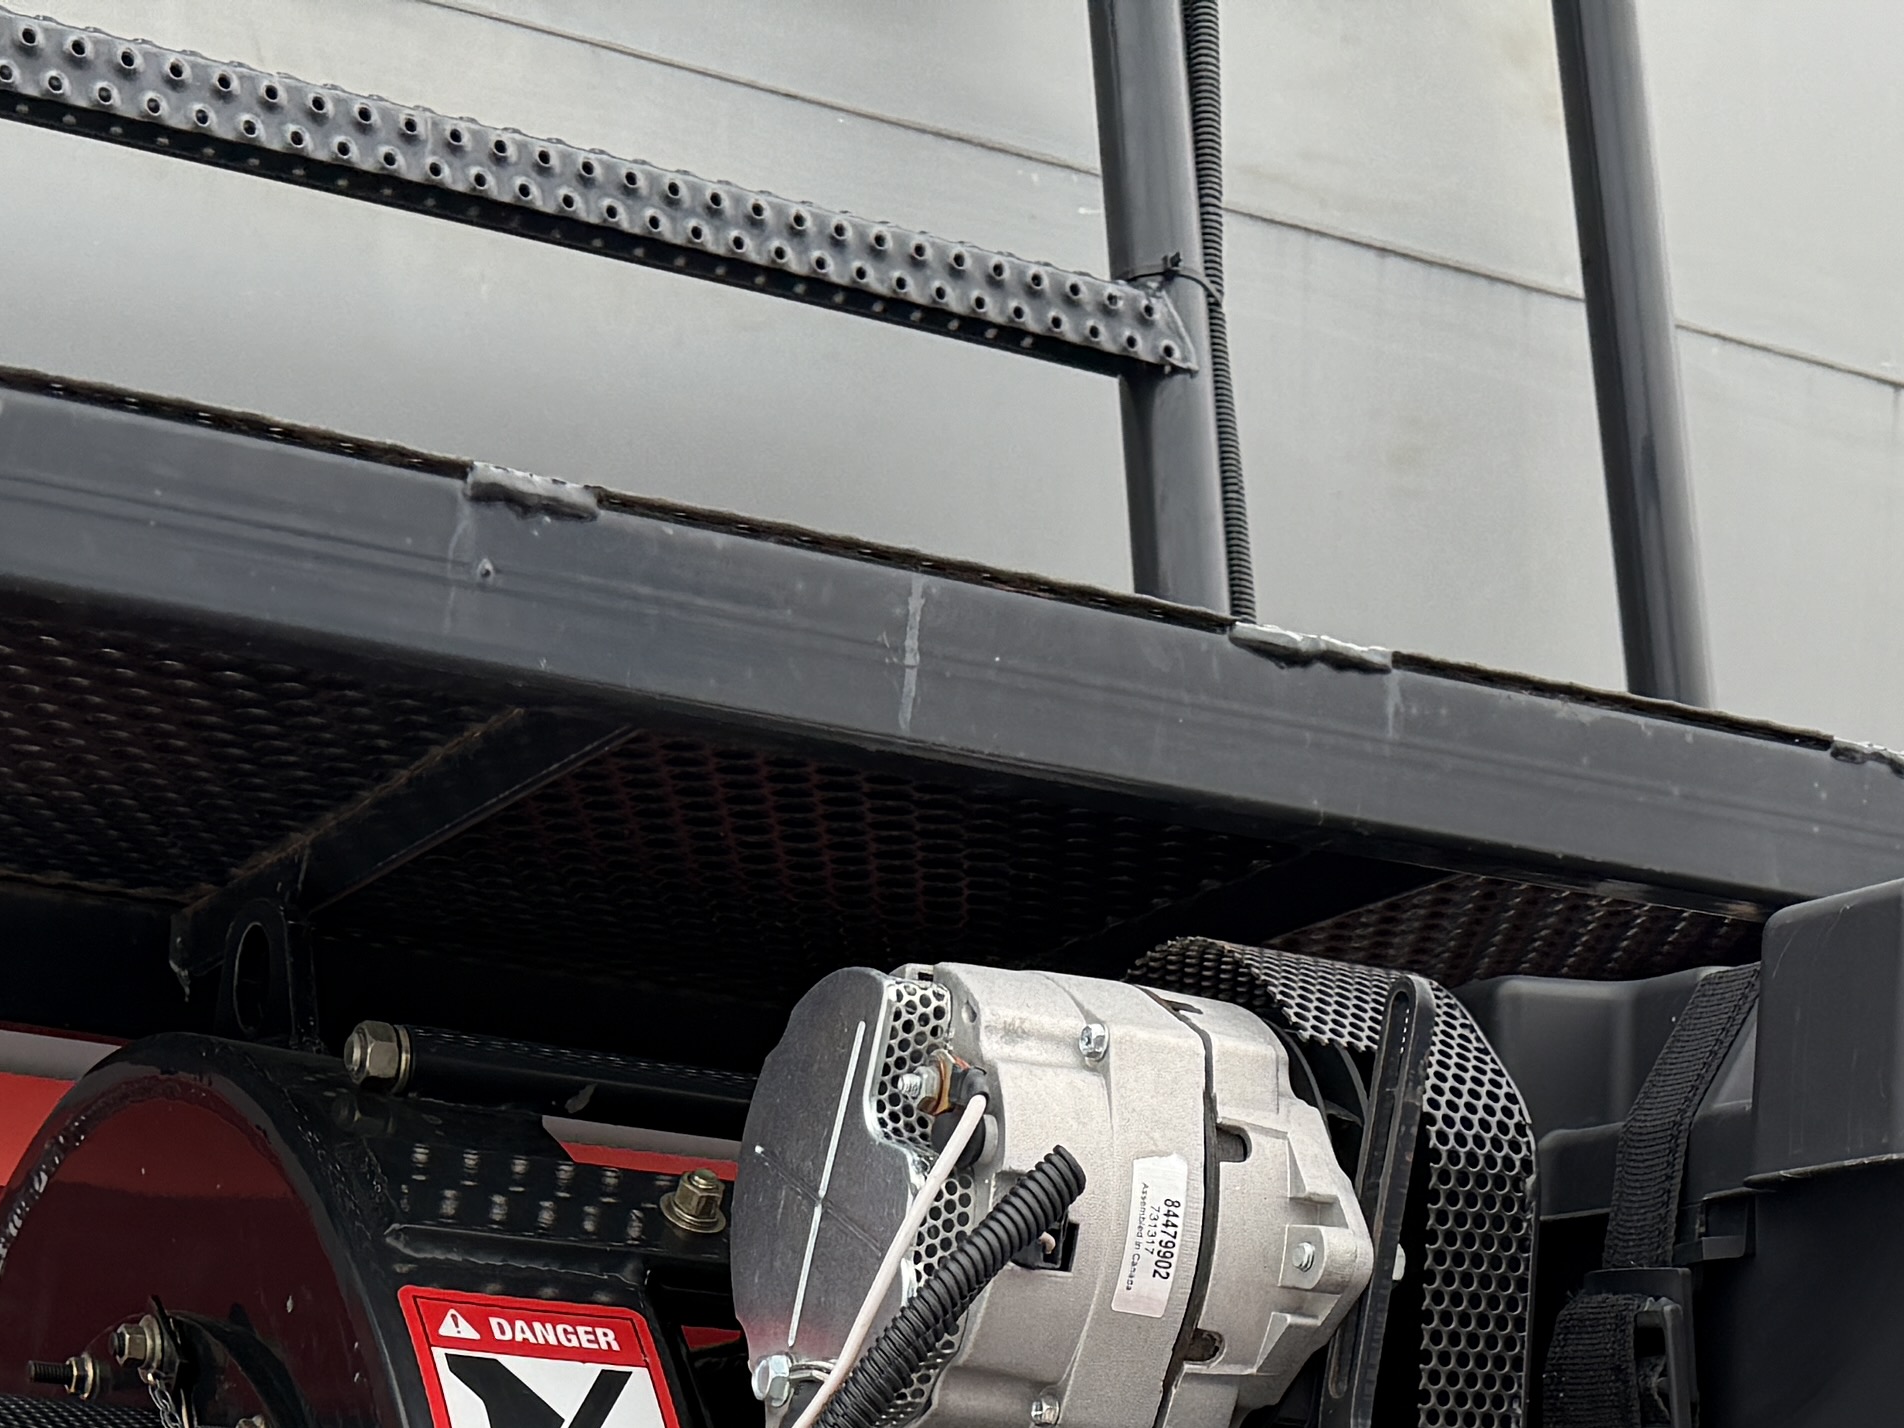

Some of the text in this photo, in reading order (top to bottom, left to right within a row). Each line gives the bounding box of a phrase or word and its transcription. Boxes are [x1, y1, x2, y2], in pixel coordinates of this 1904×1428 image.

[1137, 1182, 1149, 1237] Assembled
[1145, 1206, 1160, 1255] 731317
[1153, 1199, 1181, 1279] 84479902
[1126, 1253, 1140, 1290] Canada
[488, 1316, 621, 1352] DANGER
